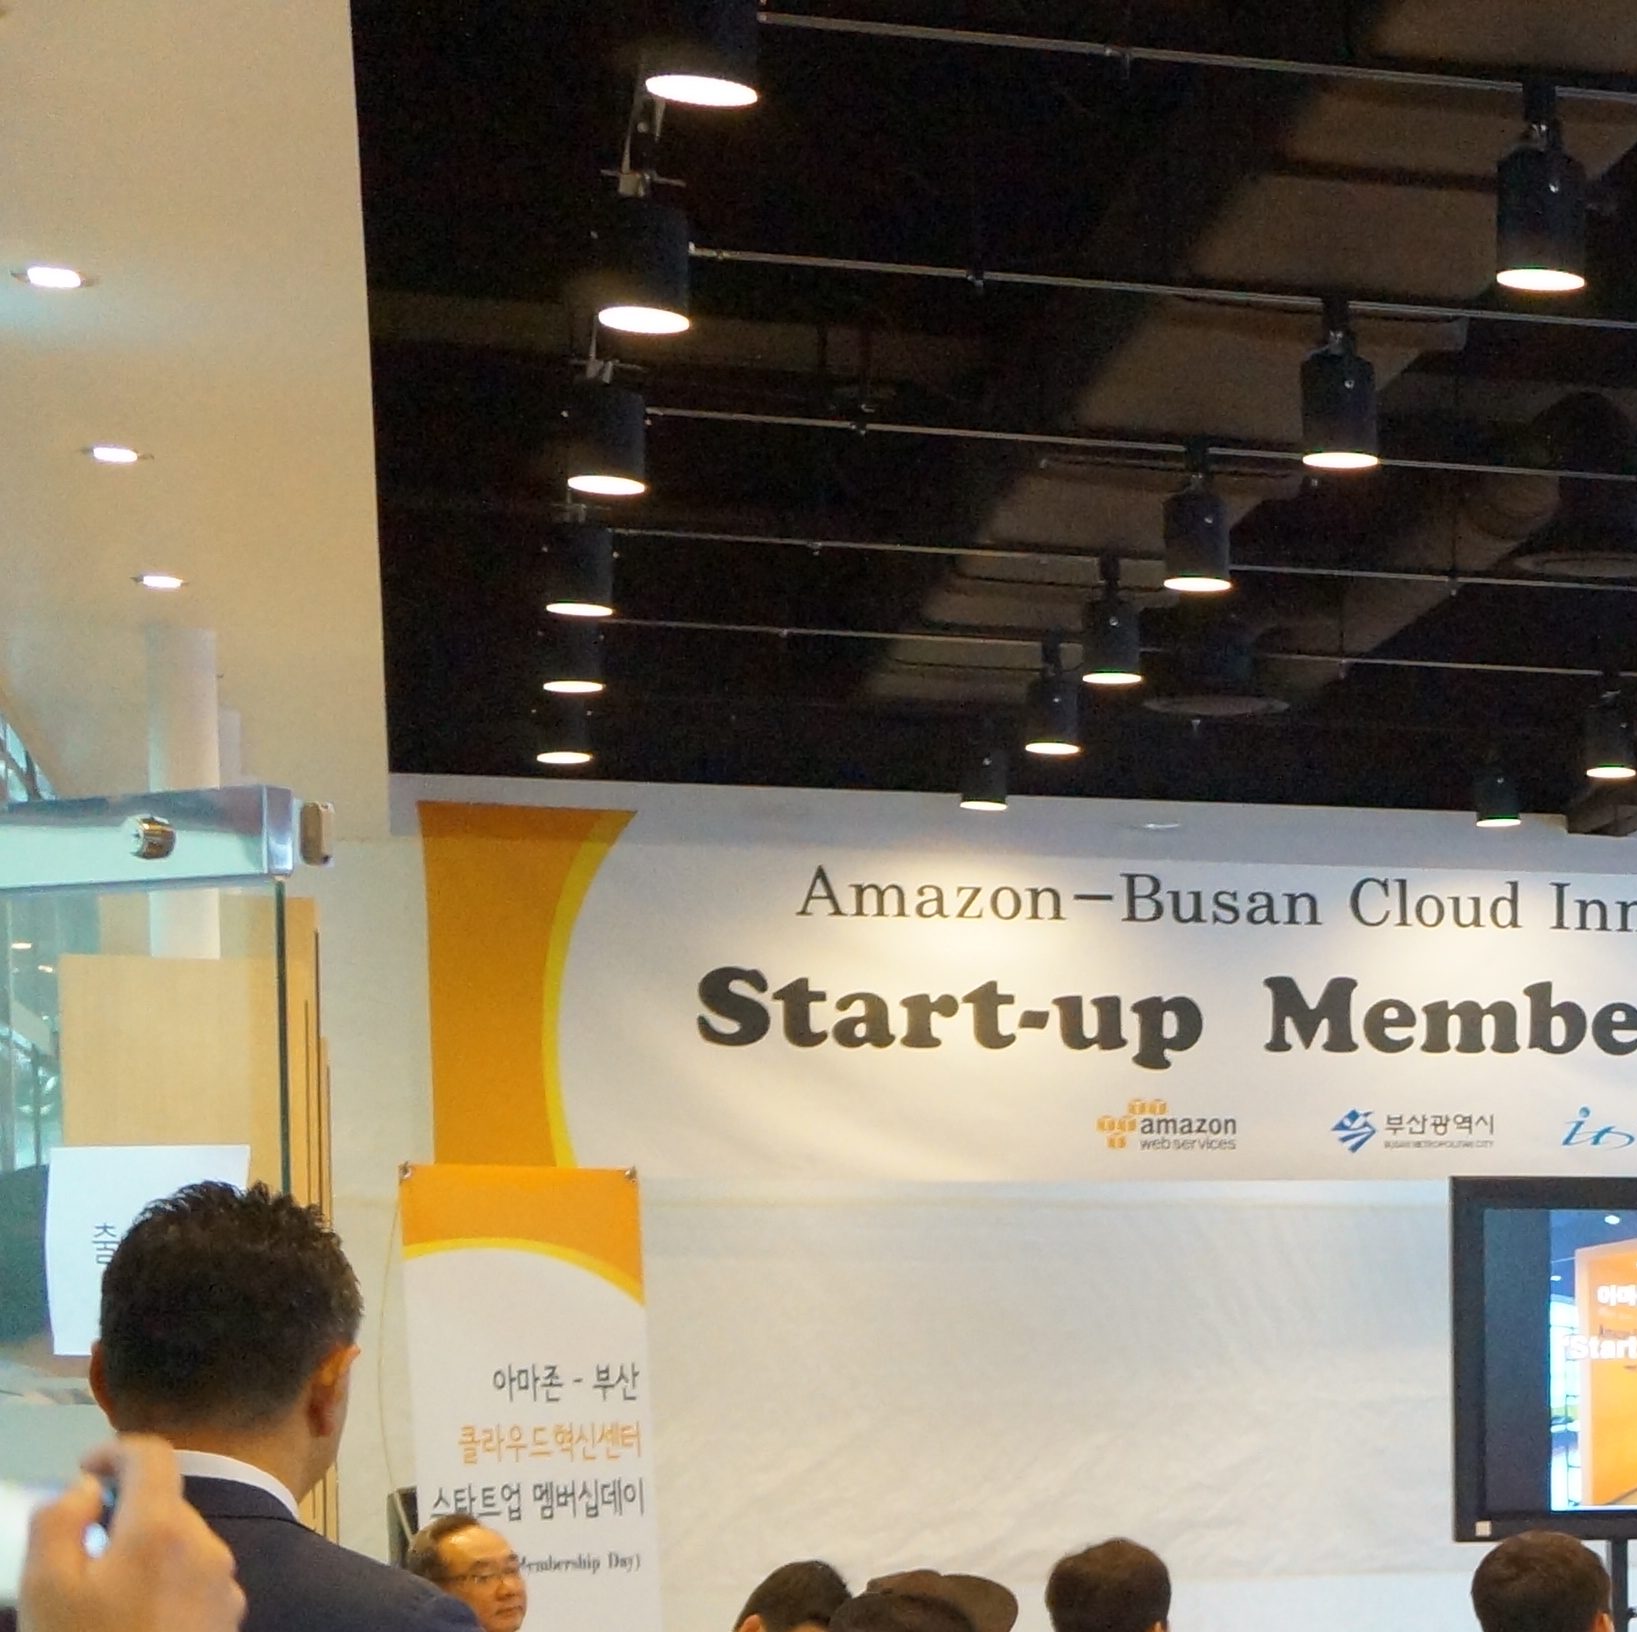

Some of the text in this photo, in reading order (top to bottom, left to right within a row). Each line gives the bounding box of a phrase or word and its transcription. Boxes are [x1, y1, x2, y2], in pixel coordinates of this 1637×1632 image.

[796, 864, 1323, 928] Amazon-Busan
[1350, 876, 1522, 932] Cloud
[696, 965, 1204, 1071] Start-up
[1140, 1114, 1237, 1135] amazon
[1384, 1113, 1495, 1137] 부산광역시
[492, 1363, 564, 1403] 아마존
[592, 1362, 641, 1402] 부산
[457, 1420, 644, 1465] 클라우드혁신센터
[429, 1476, 646, 1522] 스타트업 멤버십데이
